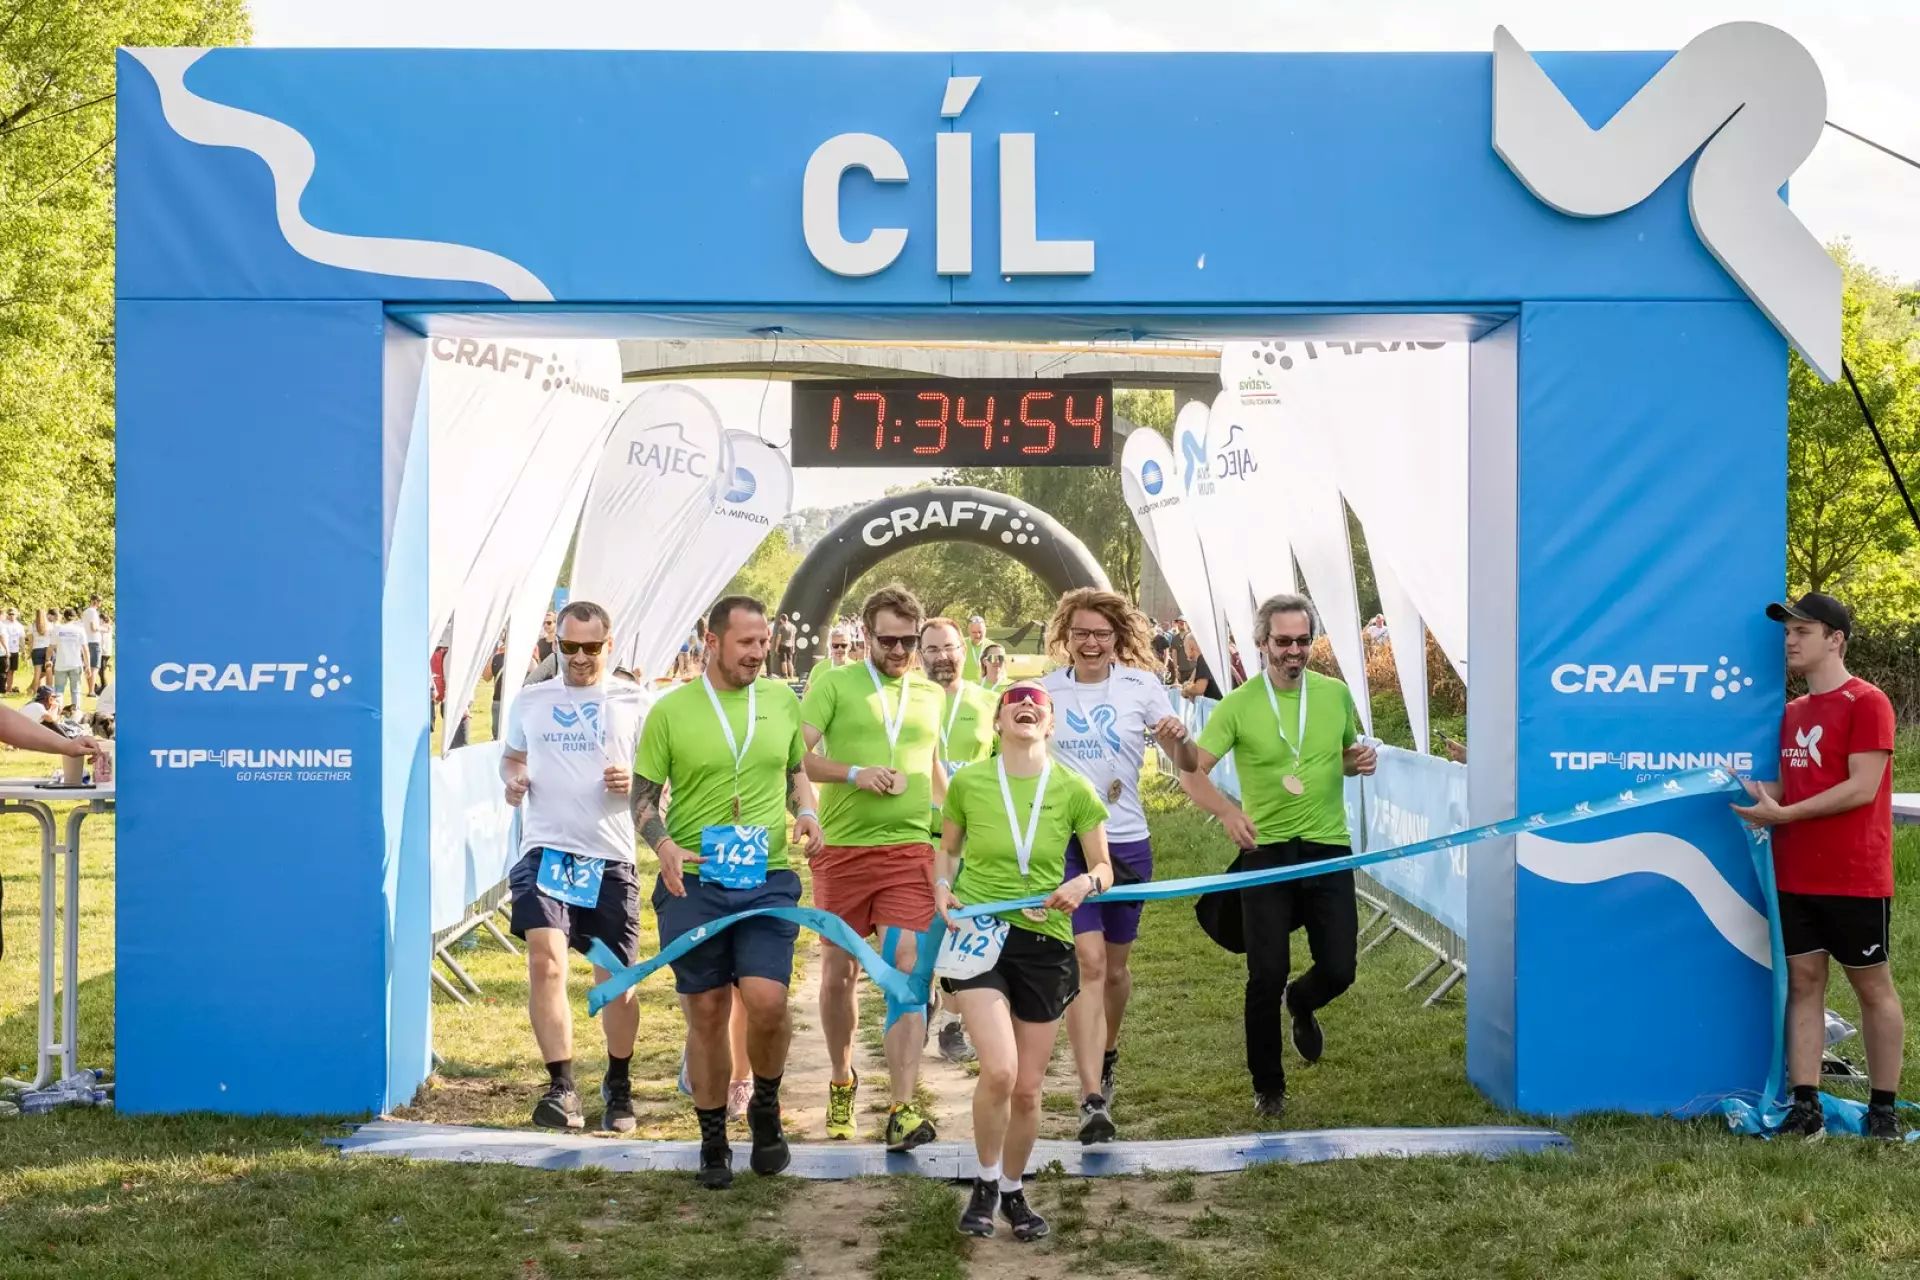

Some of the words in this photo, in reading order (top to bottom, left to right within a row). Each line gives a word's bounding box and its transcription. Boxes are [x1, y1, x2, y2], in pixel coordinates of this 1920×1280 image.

[802, 76, 1095, 277] CÍL
[431, 336, 544, 380] CRAFT
[829, 391, 1105, 454] 17:34:54
[627, 440, 708, 478] RAJEC
[729, 509, 769, 526] MINOLTA
[861, 500, 1009, 547] CRAFT
[150, 662, 309, 692] CRAFT
[1550, 663, 1709, 693] CRAFT
[543, 732, 586, 742] VLTAVA
[562, 742, 587, 752] RUN
[150, 749, 353, 769] TOP4RUNNING
[1078, 750, 1103, 760] RUN
[1550, 752, 1753, 770] TOP4RUNNING
[236, 771, 251, 782] GO
[714, 842, 757, 866] 142
[550, 863, 591, 889] 142
[949, 927, 990, 958] 142
